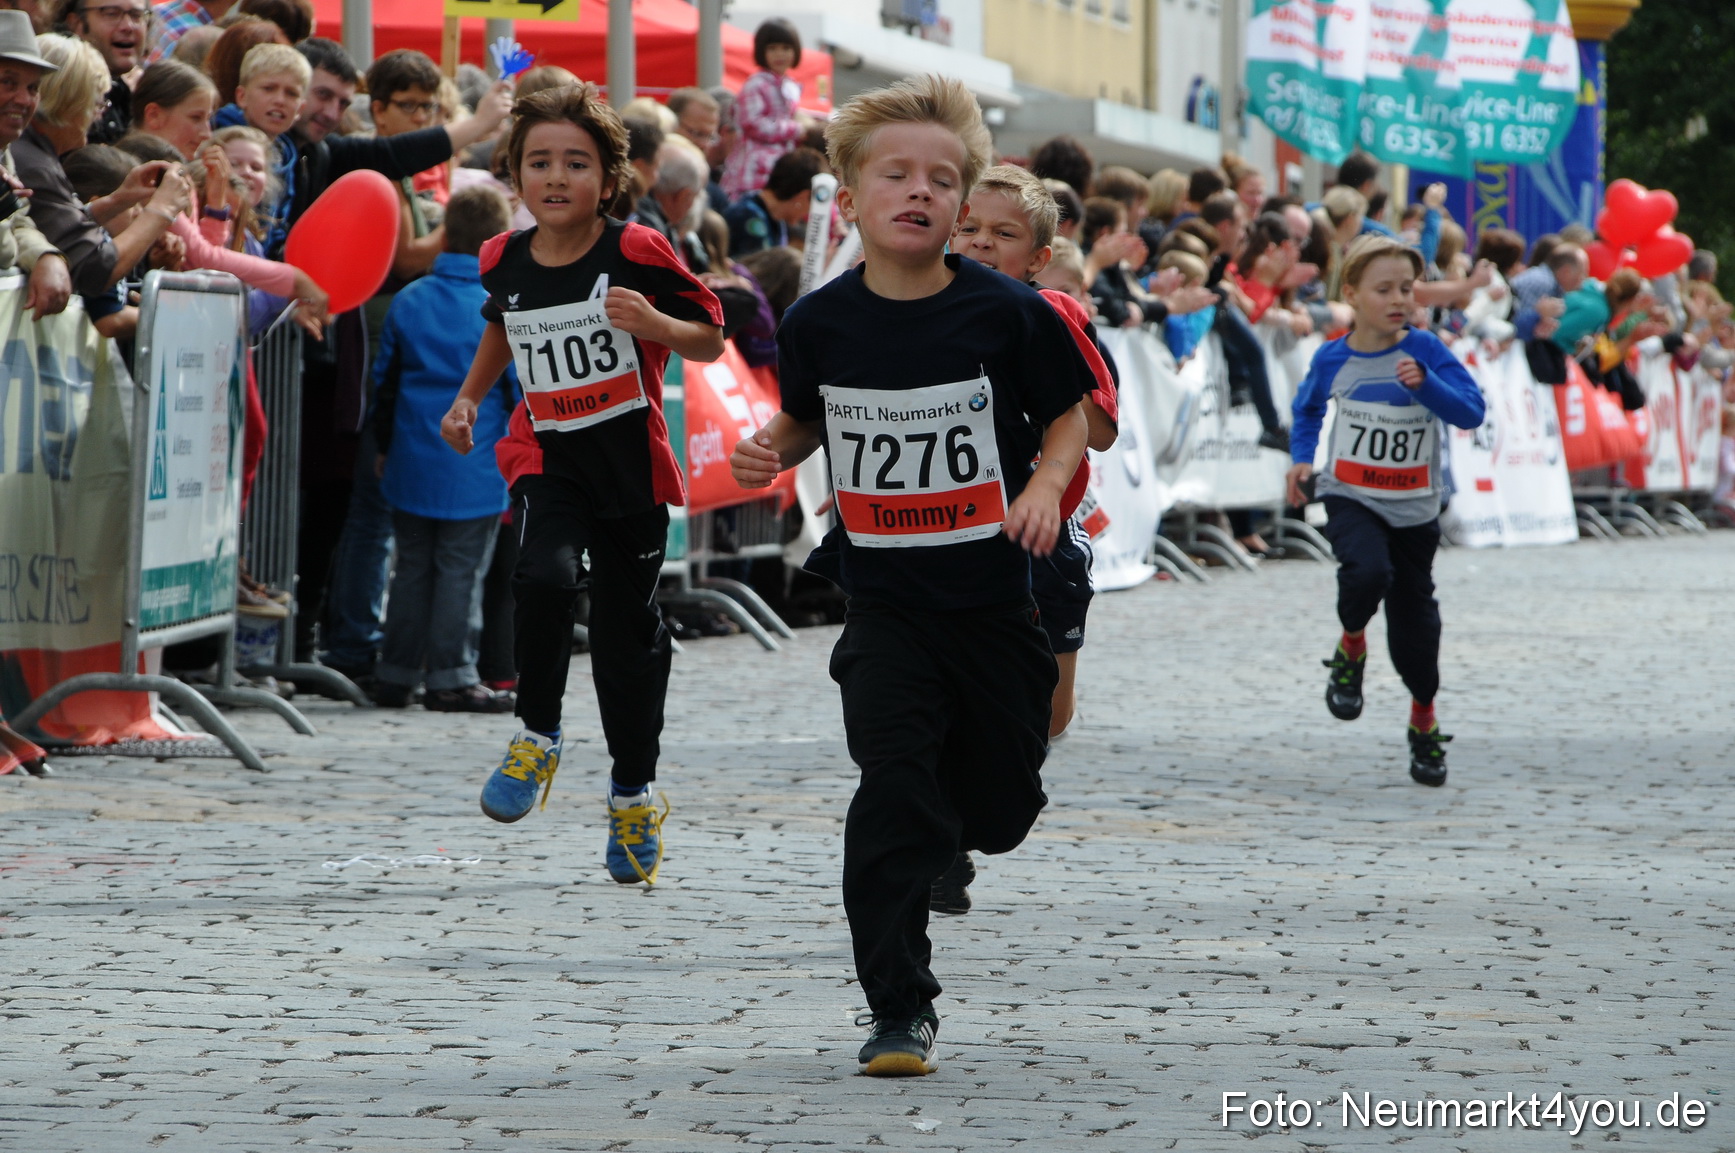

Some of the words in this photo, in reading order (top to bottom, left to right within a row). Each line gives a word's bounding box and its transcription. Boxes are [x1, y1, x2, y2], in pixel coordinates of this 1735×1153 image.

[1501, 124, 1551, 155] 6352
[507, 324, 537, 337] PARTL
[538, 313, 603, 334] Neumarkt
[519, 329, 619, 386] 7103
[552, 393, 597, 416] Nino
[827, 402, 874, 421] PARTL
[878, 401, 962, 422] Neumarkt
[1349, 423, 1426, 463] 7087
[841, 425, 980, 490] 7276
[986, 467, 995, 479] M
[1362, 469, 1409, 487] Moritz
[869, 502, 959, 529] Tommy
